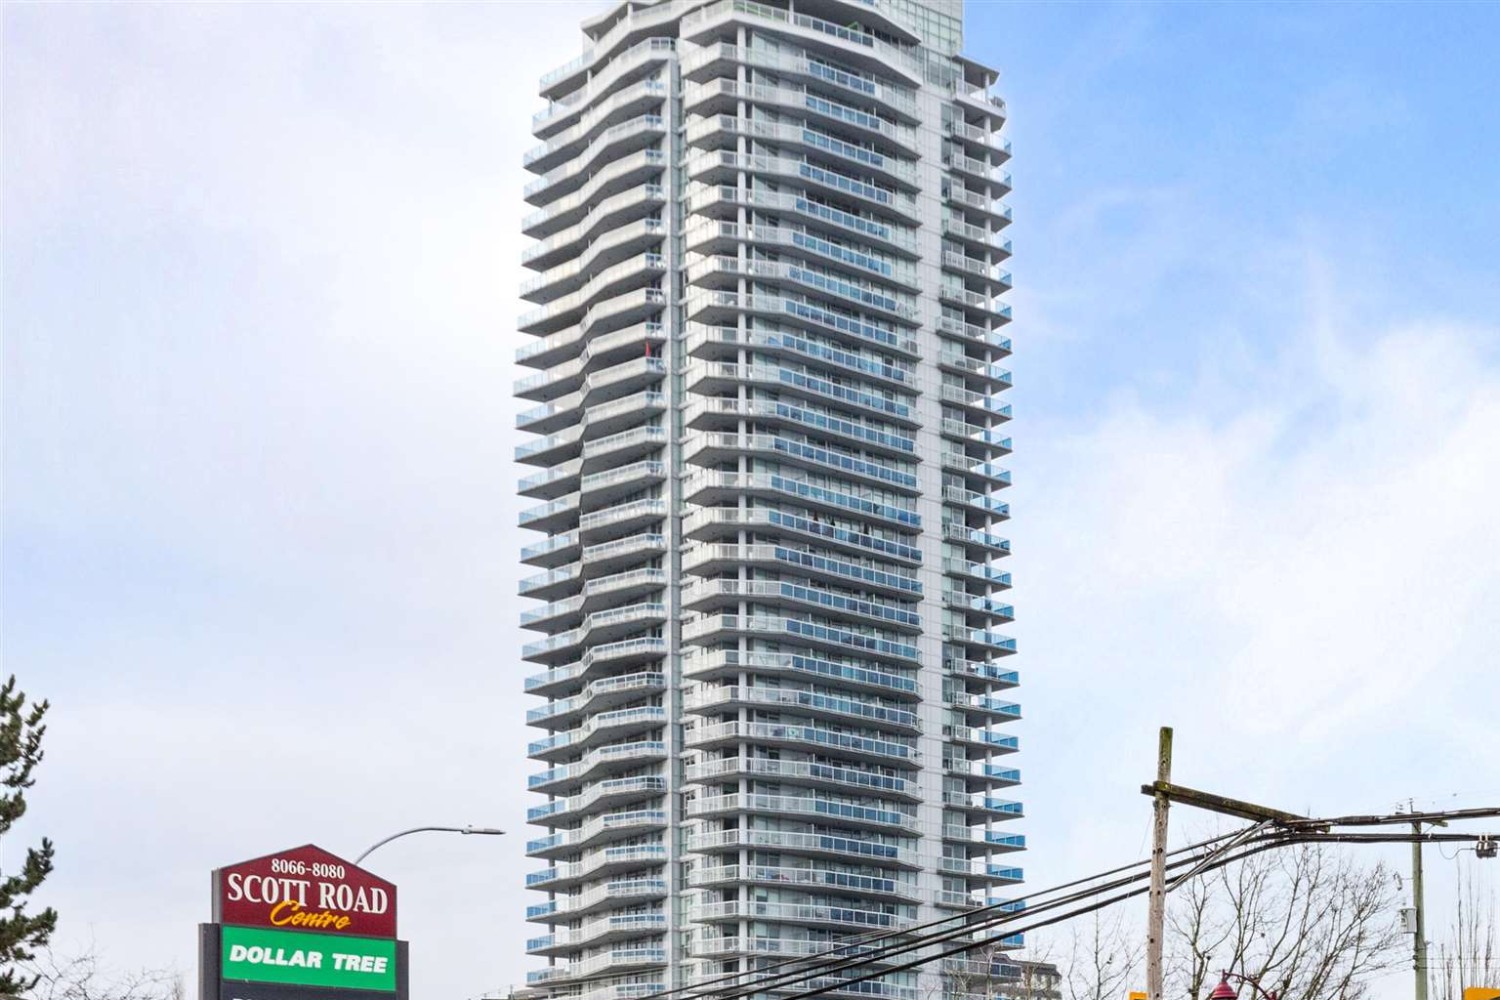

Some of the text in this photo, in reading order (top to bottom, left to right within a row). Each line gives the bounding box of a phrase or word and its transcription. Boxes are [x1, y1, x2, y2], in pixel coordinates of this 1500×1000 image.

[272, 858, 345, 879] 8066-8080
[227, 873, 388, 914] SCOTT ROAD
[270, 899, 351, 929] Centre
[229, 944, 388, 973] DOLLAR TREE
